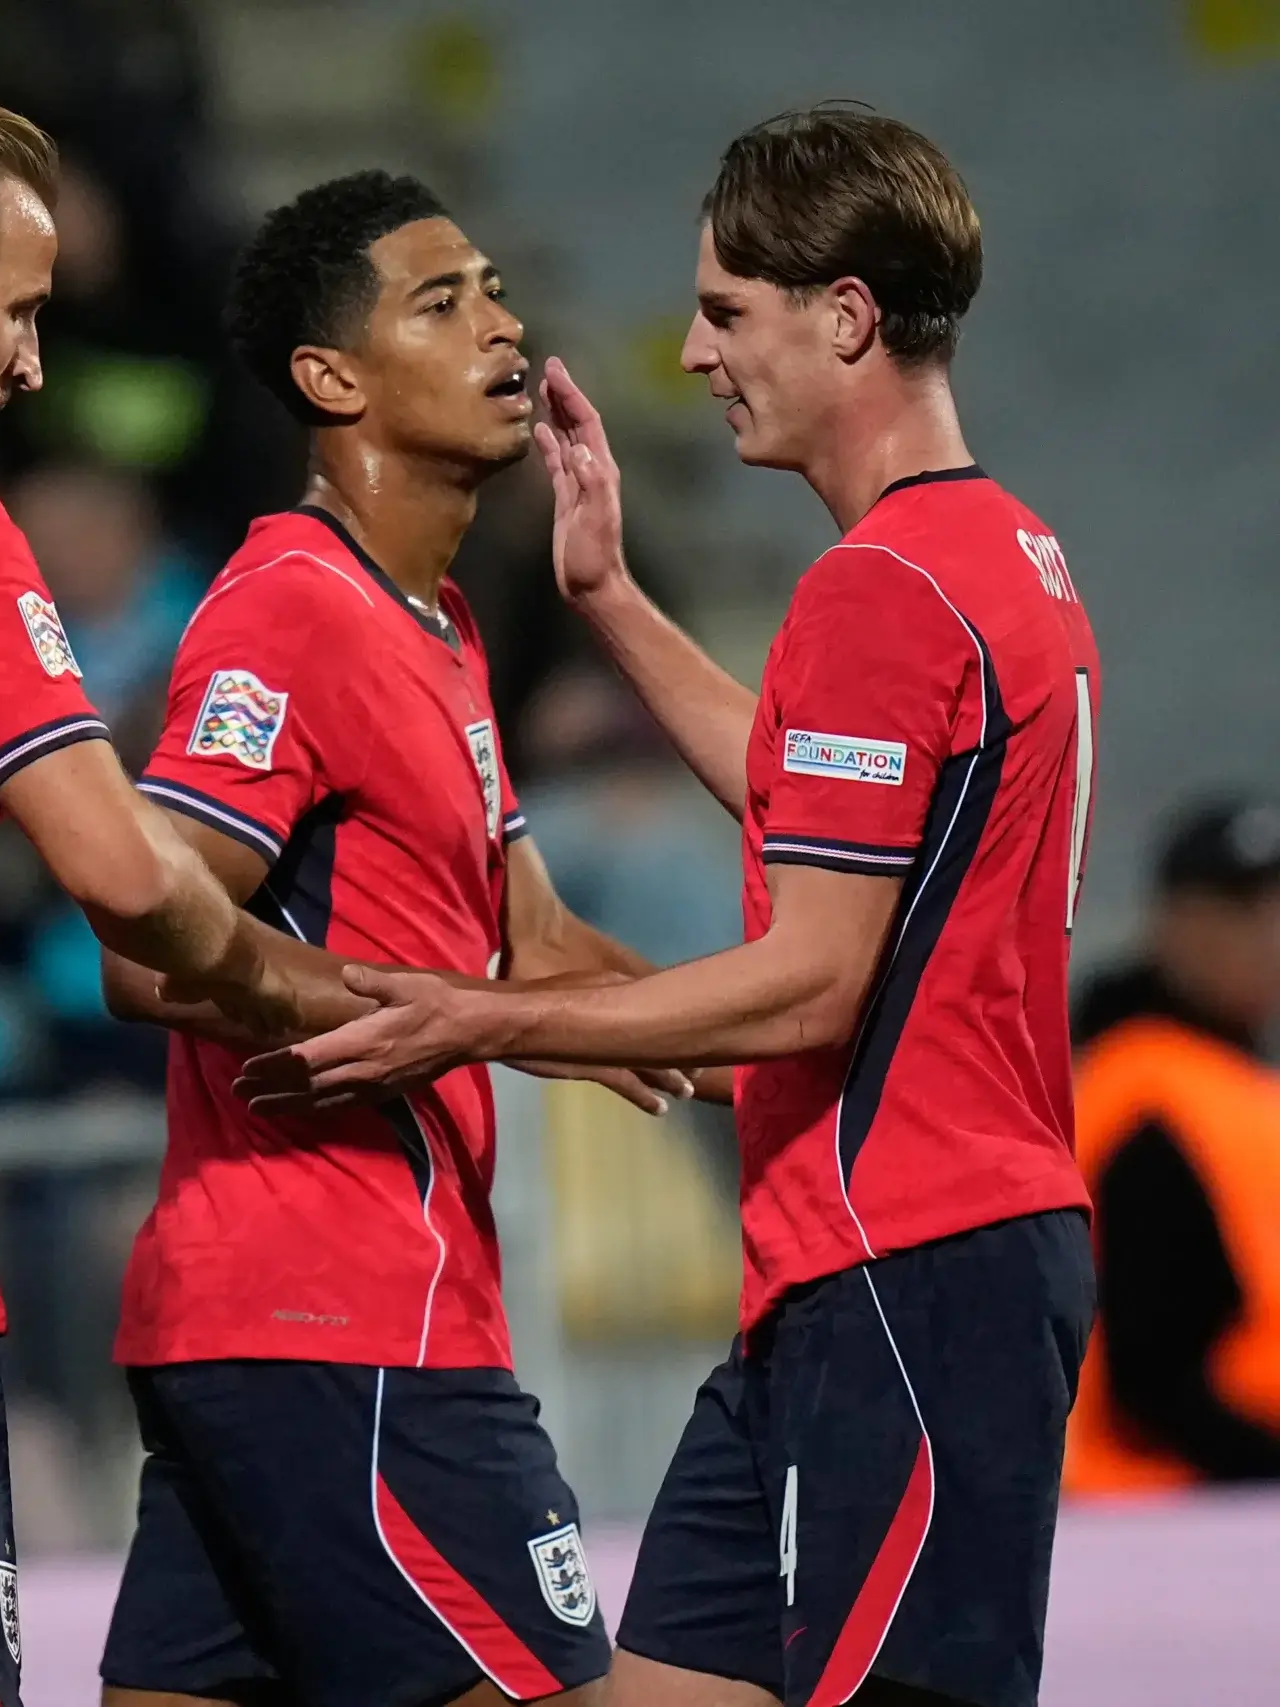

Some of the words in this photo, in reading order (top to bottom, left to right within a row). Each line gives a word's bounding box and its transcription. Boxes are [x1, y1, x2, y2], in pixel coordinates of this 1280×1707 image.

[788, 732, 812, 744] UEFA
[787, 743, 902, 771] FOUNDATION
[859, 769, 870, 779] for
[872, 771, 900, 782] children
[779, 1464, 798, 1606] 4
